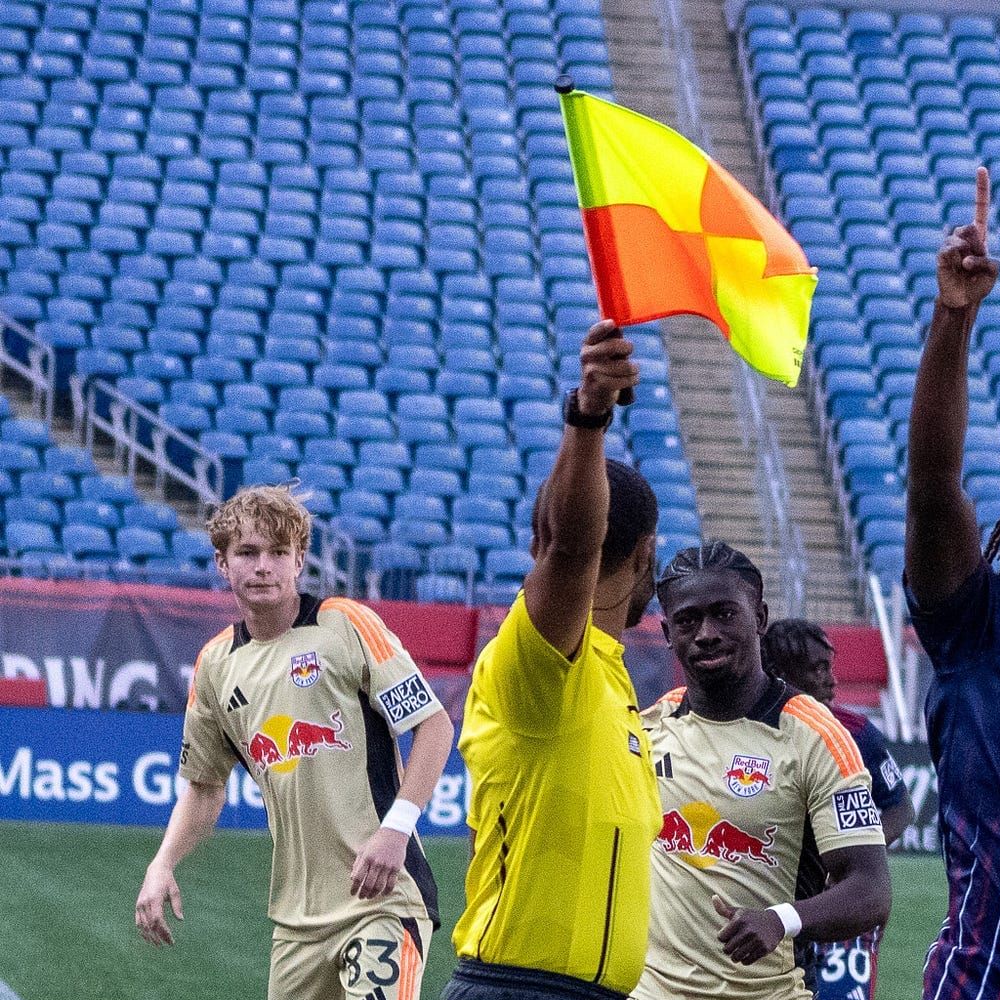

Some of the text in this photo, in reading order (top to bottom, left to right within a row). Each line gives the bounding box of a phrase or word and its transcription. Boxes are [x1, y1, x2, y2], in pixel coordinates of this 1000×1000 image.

[390, 676, 420, 706] NEXT
[401, 690, 429, 713] PRO
[0, 746, 120, 801] Mass
[342, 937, 400, 987] 83
[821, 948, 870, 983] 30
